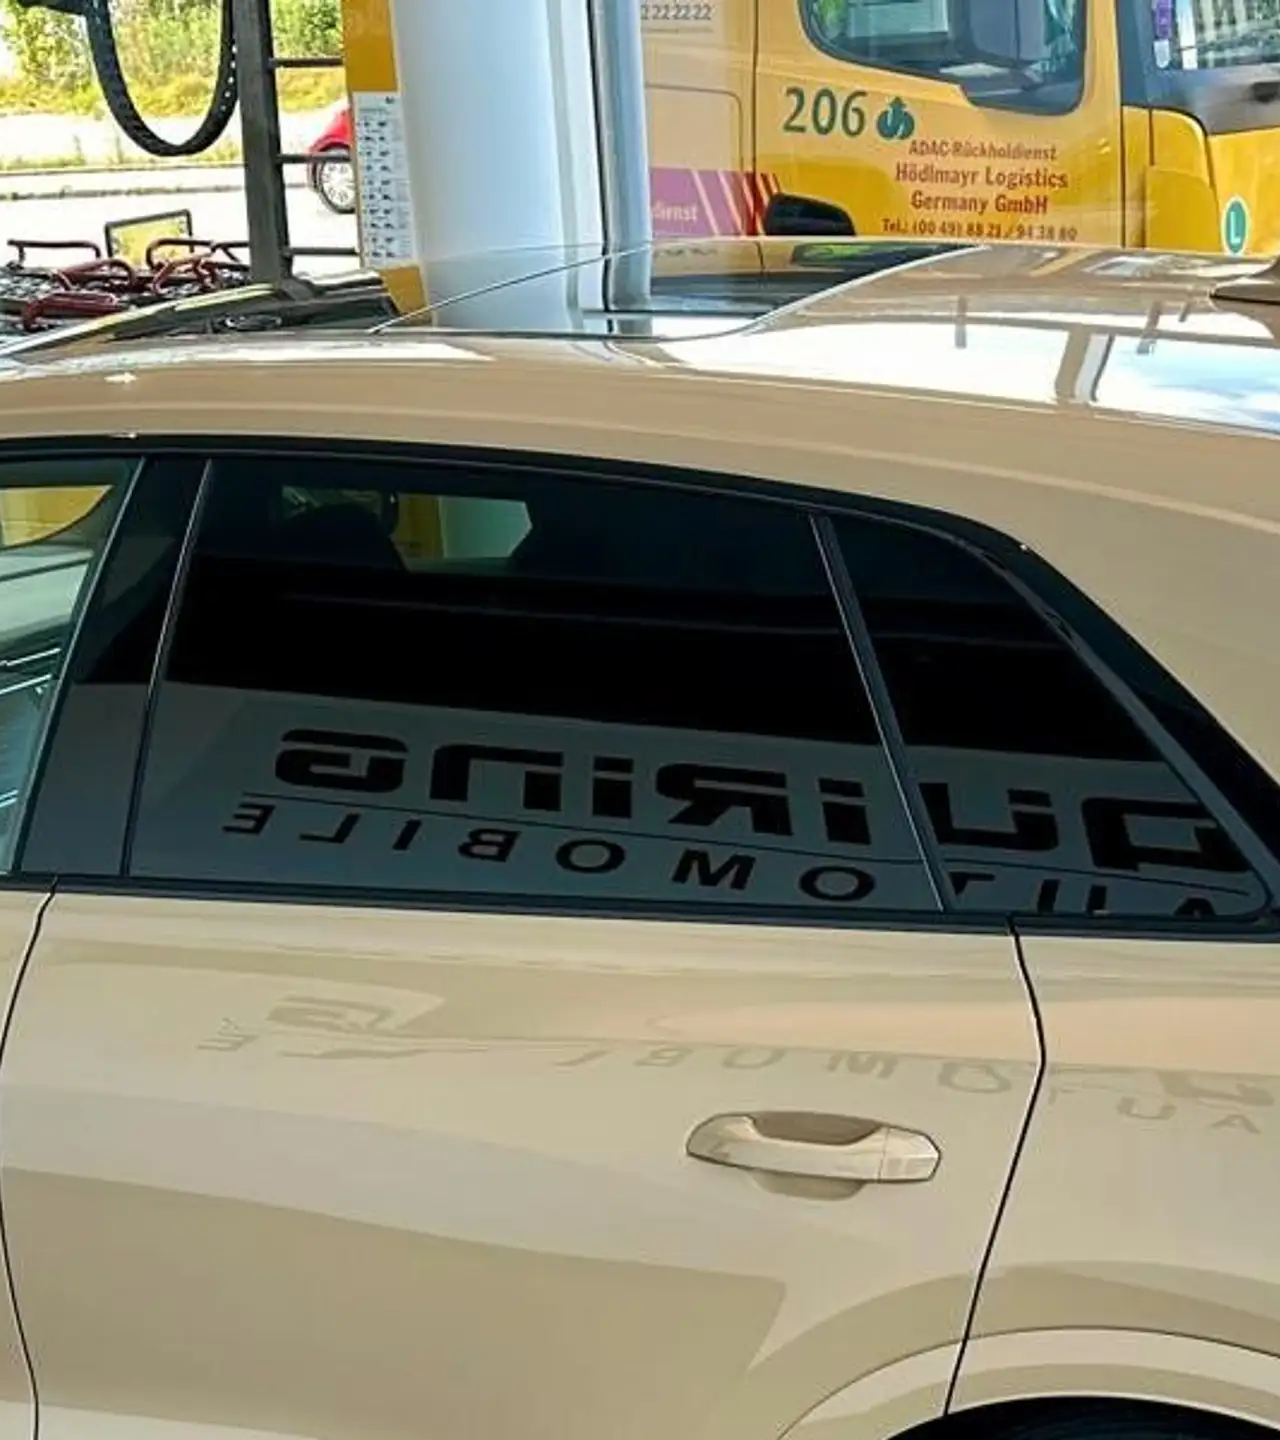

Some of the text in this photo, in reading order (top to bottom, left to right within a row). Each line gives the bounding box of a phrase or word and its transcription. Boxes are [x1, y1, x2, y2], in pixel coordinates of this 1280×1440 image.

[782, 87, 868, 137] 206
[896, 162, 1069, 189] Hödlmayr Logistics
[910, 191, 1048, 215] Germany GmbH
[1229, 210, 1242, 244] L
